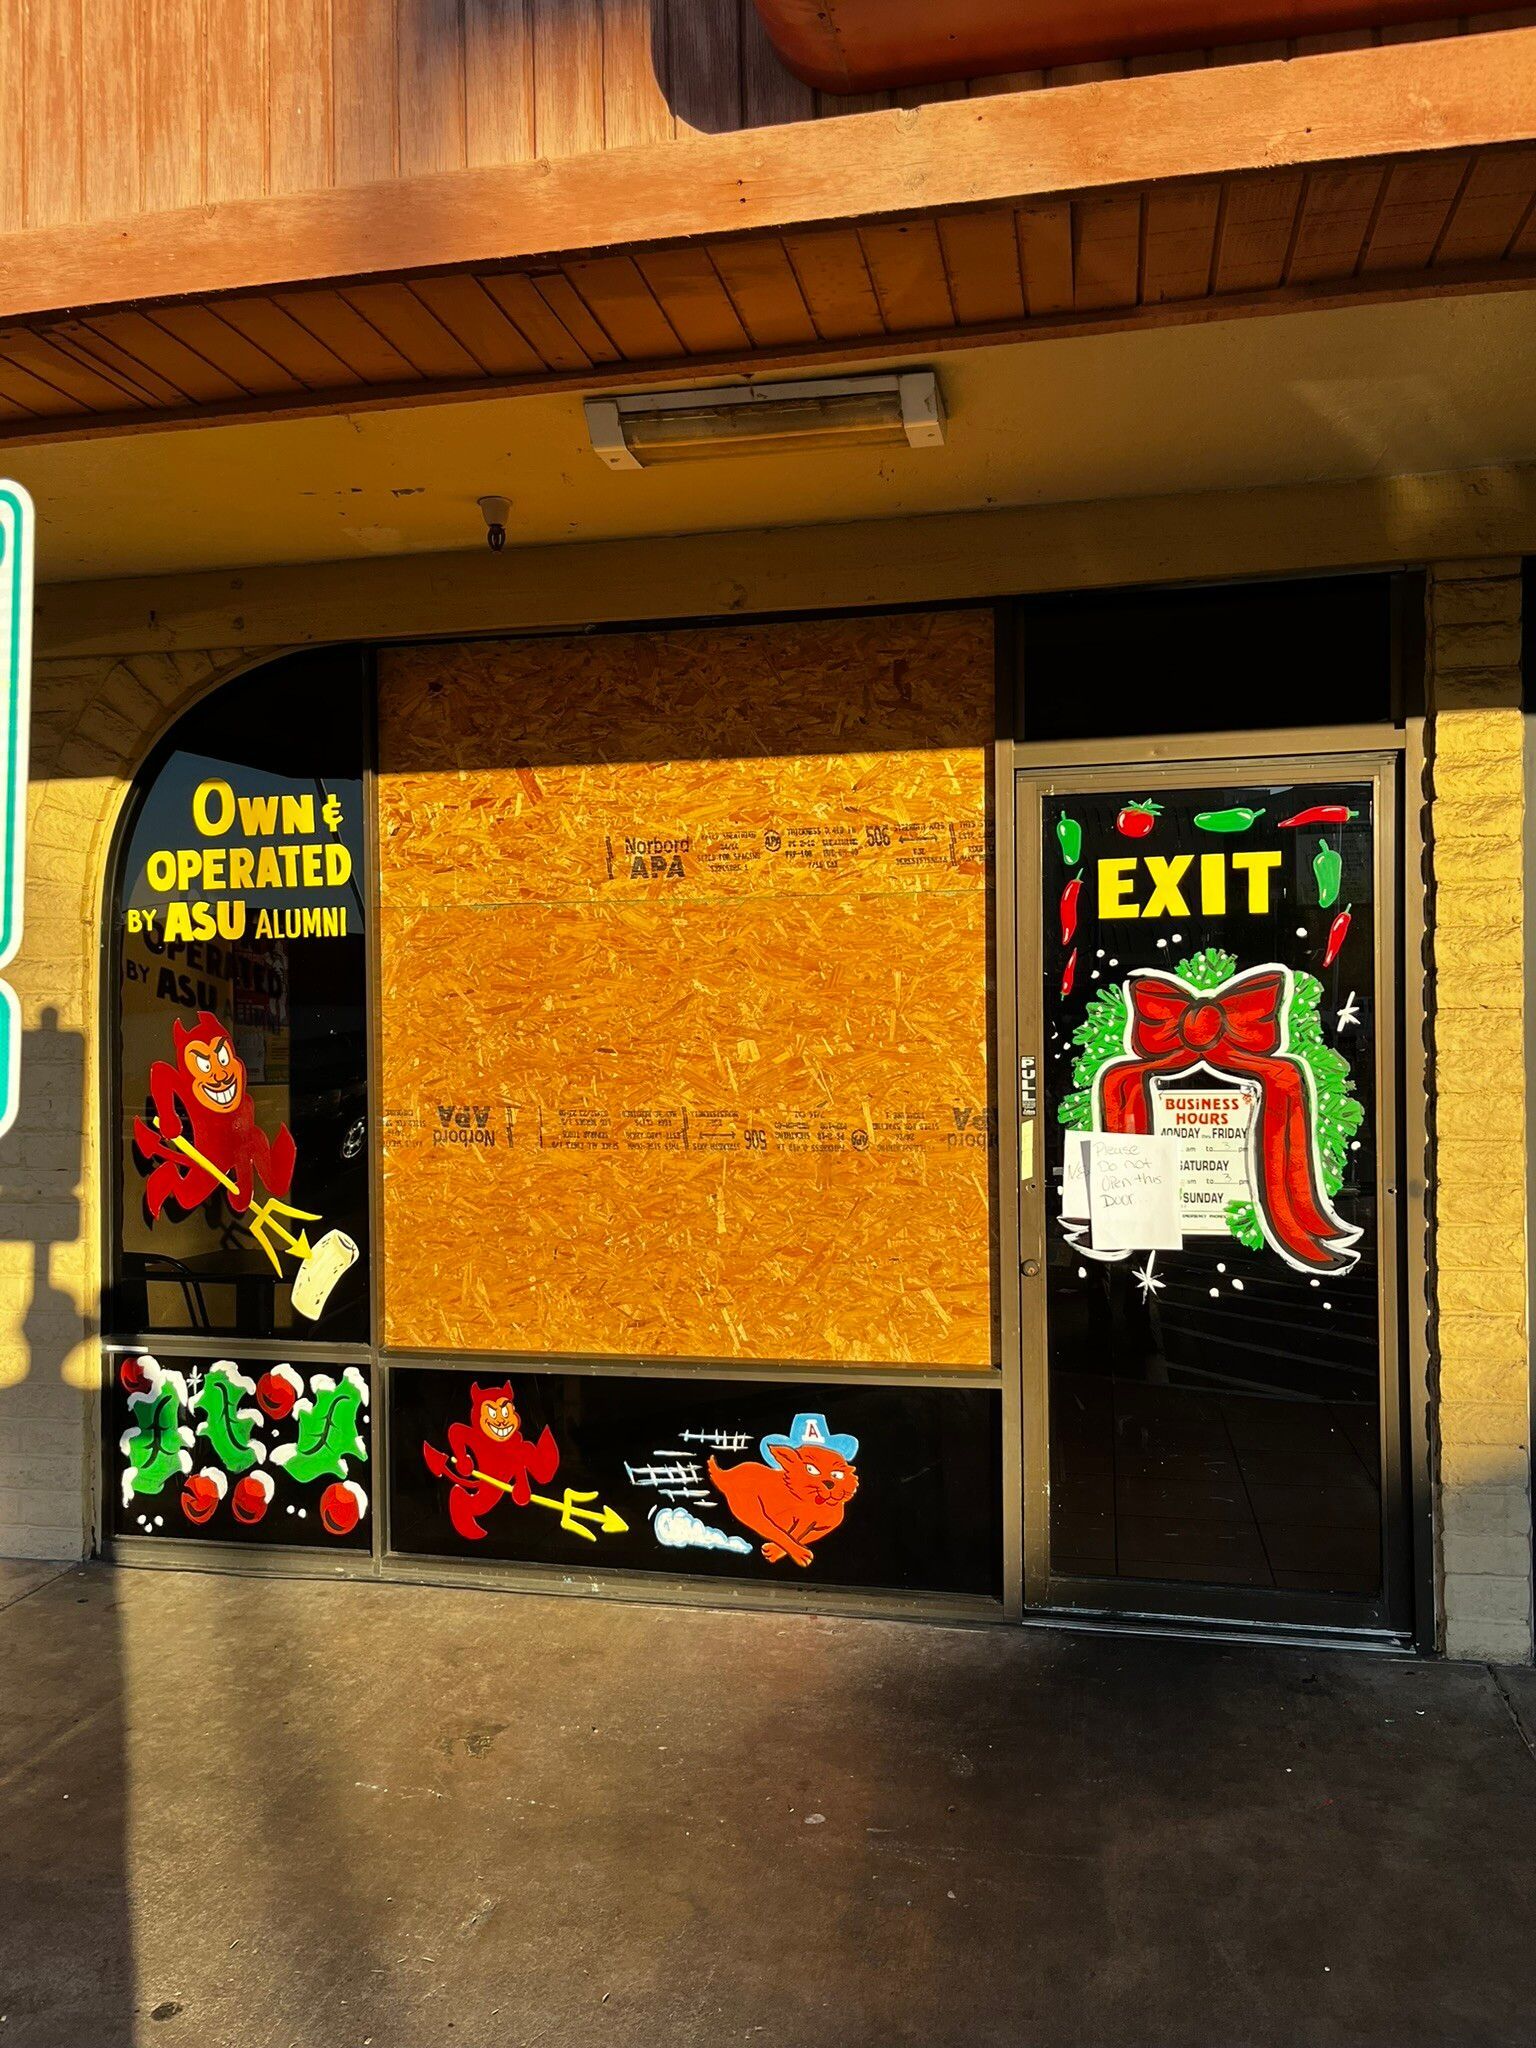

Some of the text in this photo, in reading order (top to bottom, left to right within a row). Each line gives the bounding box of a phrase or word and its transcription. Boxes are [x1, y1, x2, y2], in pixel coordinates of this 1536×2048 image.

[321, 793, 344, 832] &
[624, 836, 690, 854] Norbord
[866, 826, 891, 847] 506
[147, 843, 352, 892] OPERATED
[630, 855, 686, 879] APA
[1098, 851, 1282, 919] EXIT
[127, 900, 347, 942] BY ASU ALUMNI
[1021, 1056, 1036, 1101] PULL
[437, 1105, 491, 1128] APA
[1176, 1112, 1229, 1126] HOURS
[433, 1129, 496, 1148] Norbord
[743, 1130, 768, 1150] 506
[1212, 1127, 1247, 1139] FRIDAY
[1093, 1141, 1140, 1156] Please
[1096, 1159, 1118, 1172] Do
[1124, 1157, 1152, 1169] not
[1134, 1173, 1162, 1185] this
[1100, 1194, 1135, 1208] Door
[1183, 1192, 1224, 1204] SUNDAY
[801, 1418, 826, 1444] A
